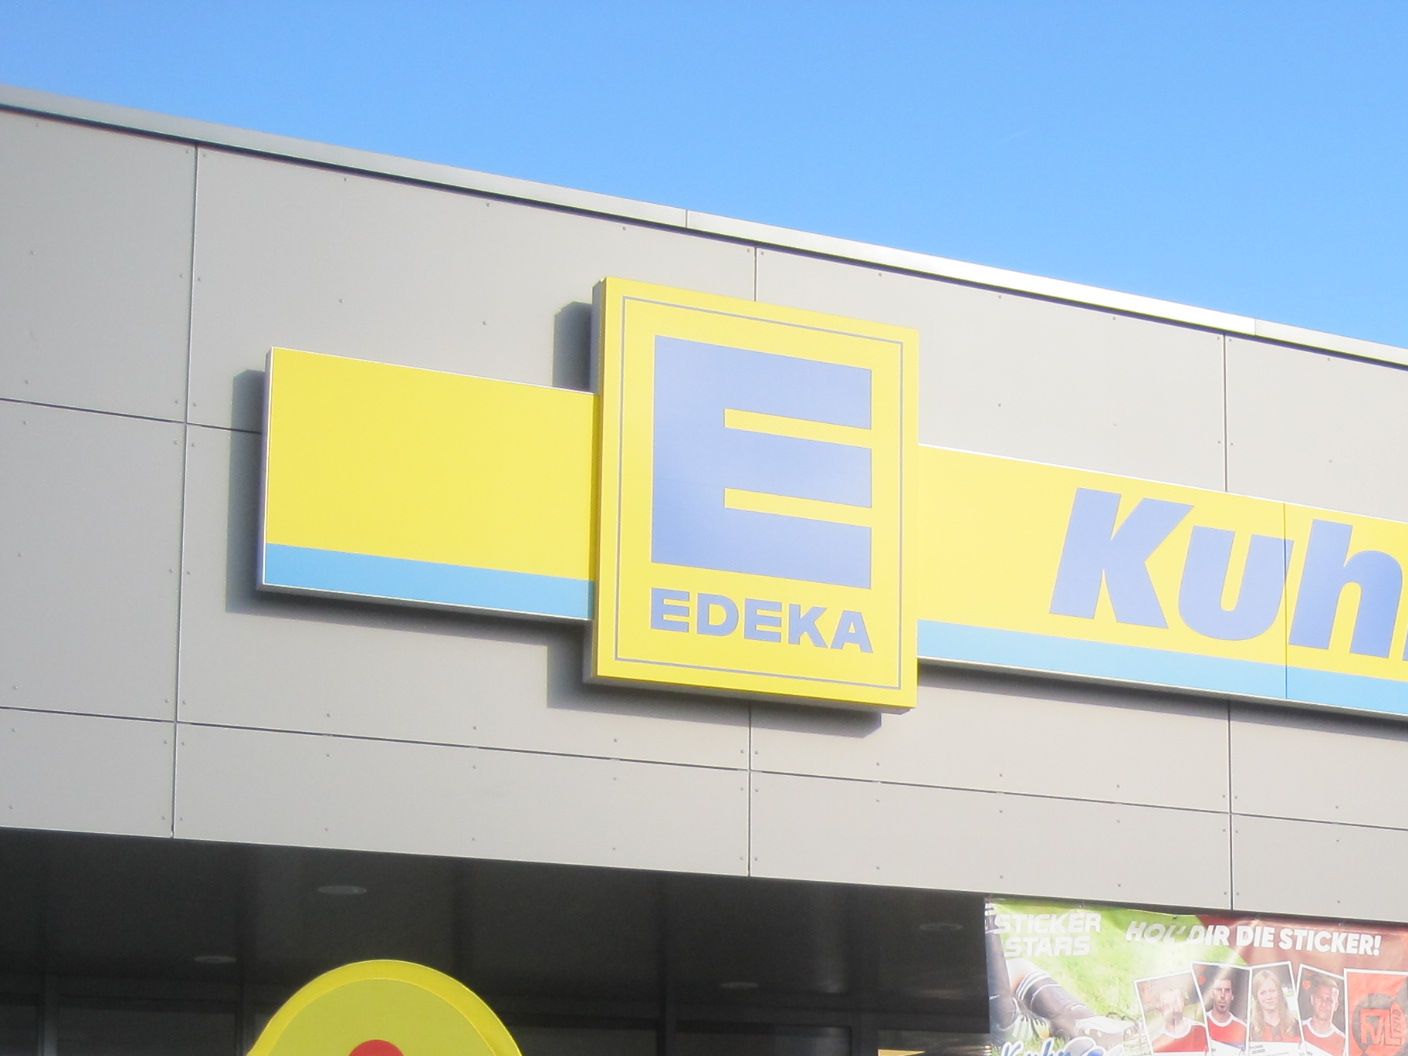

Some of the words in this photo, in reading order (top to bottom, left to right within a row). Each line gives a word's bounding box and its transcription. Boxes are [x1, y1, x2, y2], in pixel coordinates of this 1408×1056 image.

[651, 335, 872, 589] E
[651, 588, 873, 653] EDEKA
[996, 913, 1100, 933] STICKER
[1004, 935, 1091, 957] STARS
[1187, 925, 1230, 945] DIR
[1236, 926, 1275, 947] DIE
[1279, 928, 1382, 955] STICKER!
